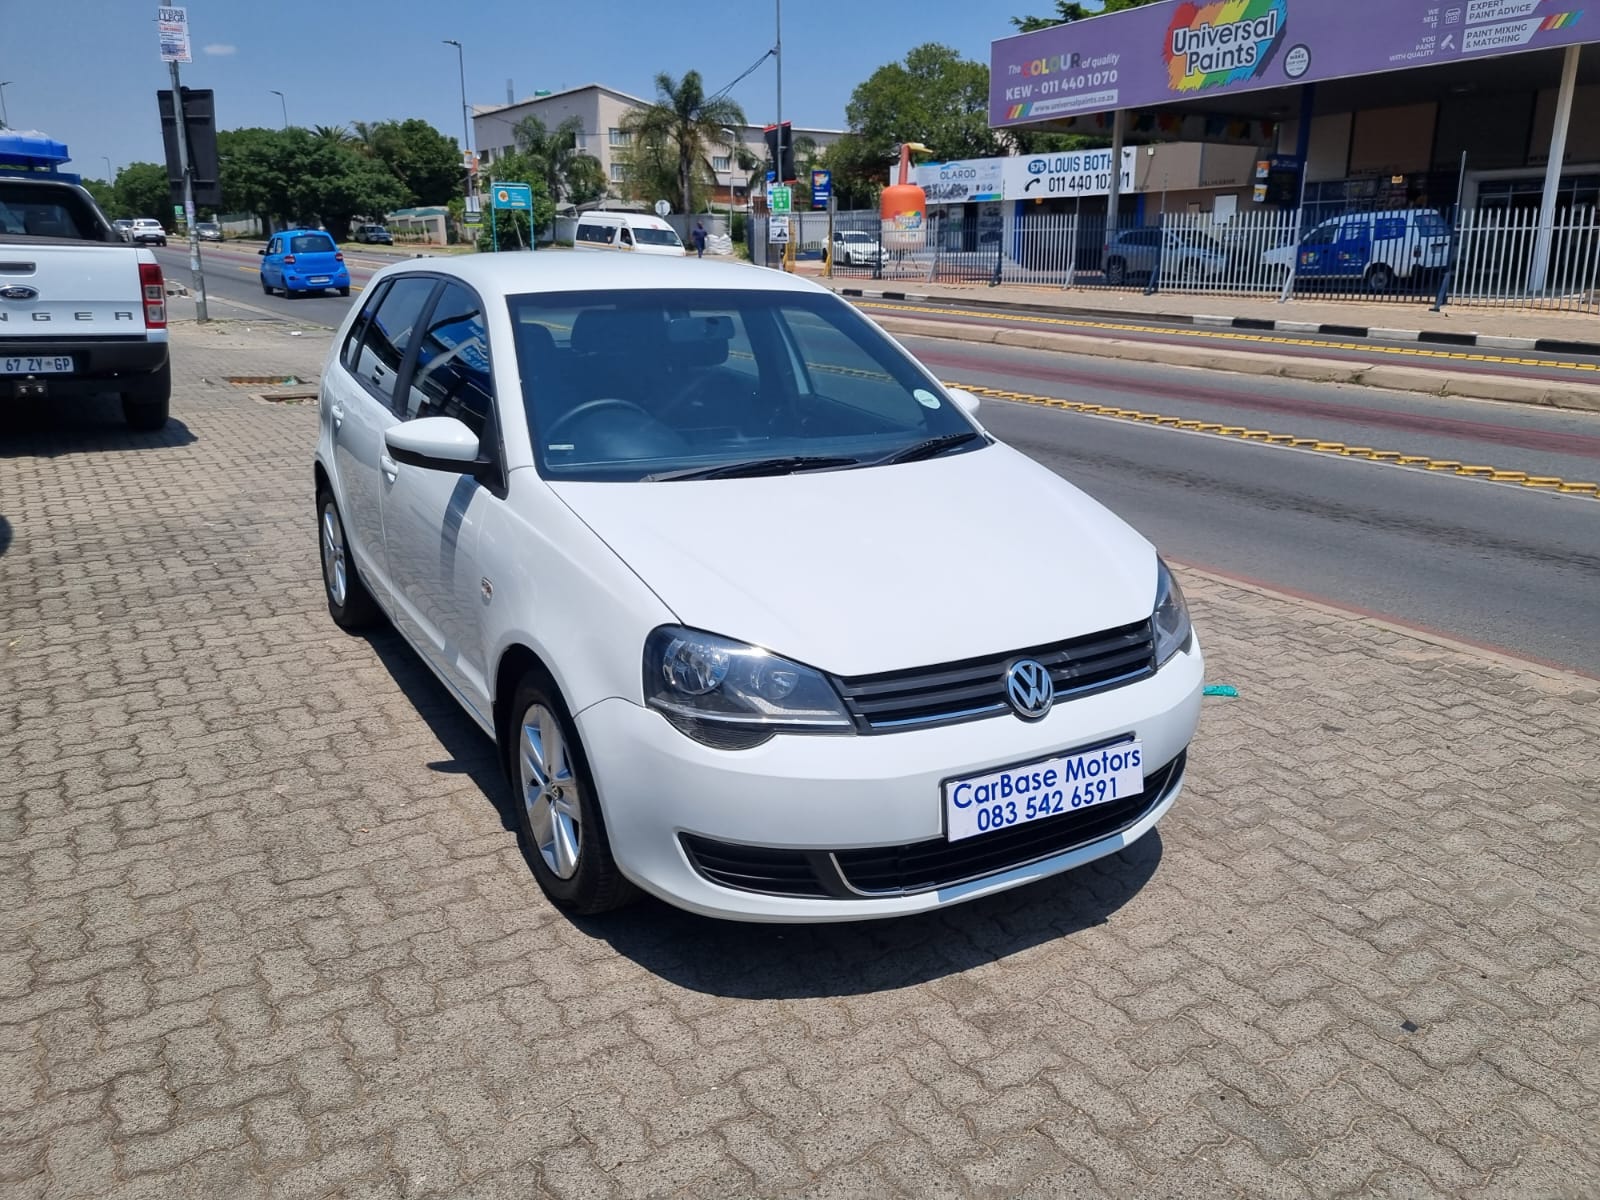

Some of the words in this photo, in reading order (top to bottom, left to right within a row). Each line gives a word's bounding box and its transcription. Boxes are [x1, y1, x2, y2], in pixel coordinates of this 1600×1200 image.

[1469, 9, 1496, 19] PAINT
[1497, 3, 1532, 16] ADVICE
[1470, 0, 1504, 11] EXPERT
[1423, 15, 1438, 23] SELL
[1174, 11, 1276, 53] Universal
[1421, 35, 1436, 43] YOU
[1466, 28, 1493, 39] PAINT
[1494, 23, 1528, 35] MIXING
[1415, 42, 1436, 51] PAINT
[1465, 40, 1471, 48] &
[1472, 33, 1521, 47] MATCHING
[1187, 43, 1256, 73] Paints
[1406, 49, 1434, 60] QUALITY
[1008, 64, 1022, 76] The
[1022, 52, 1081, 78] COLOUR
[1081, 57, 1092, 69] of
[1091, 53, 1120, 69] quality
[1006, 85, 1033, 101] KEW
[1041, 80, 1059, 94] 011
[1061, 75, 1085, 91] 440
[1087, 70, 1118, 87] 1070
[1047, 156, 1080, 174] LOUIS
[1083, 153, 1121, 171] BOTH
[1048, 176, 1066, 192] 011
[1068, 174, 1092, 190] 440
[5, 288, 30, 299] Ford
[6, 359, 21, 371] 67
[28, 359, 43, 371] ZY
[54, 358, 70, 370] GP
[953, 768, 1058, 809] CarBase
[1065, 749, 1141, 783] Motors
[977, 802, 1018, 831] 083
[1025, 790, 1064, 820] 542
[1070, 777, 1118, 807] 6591
